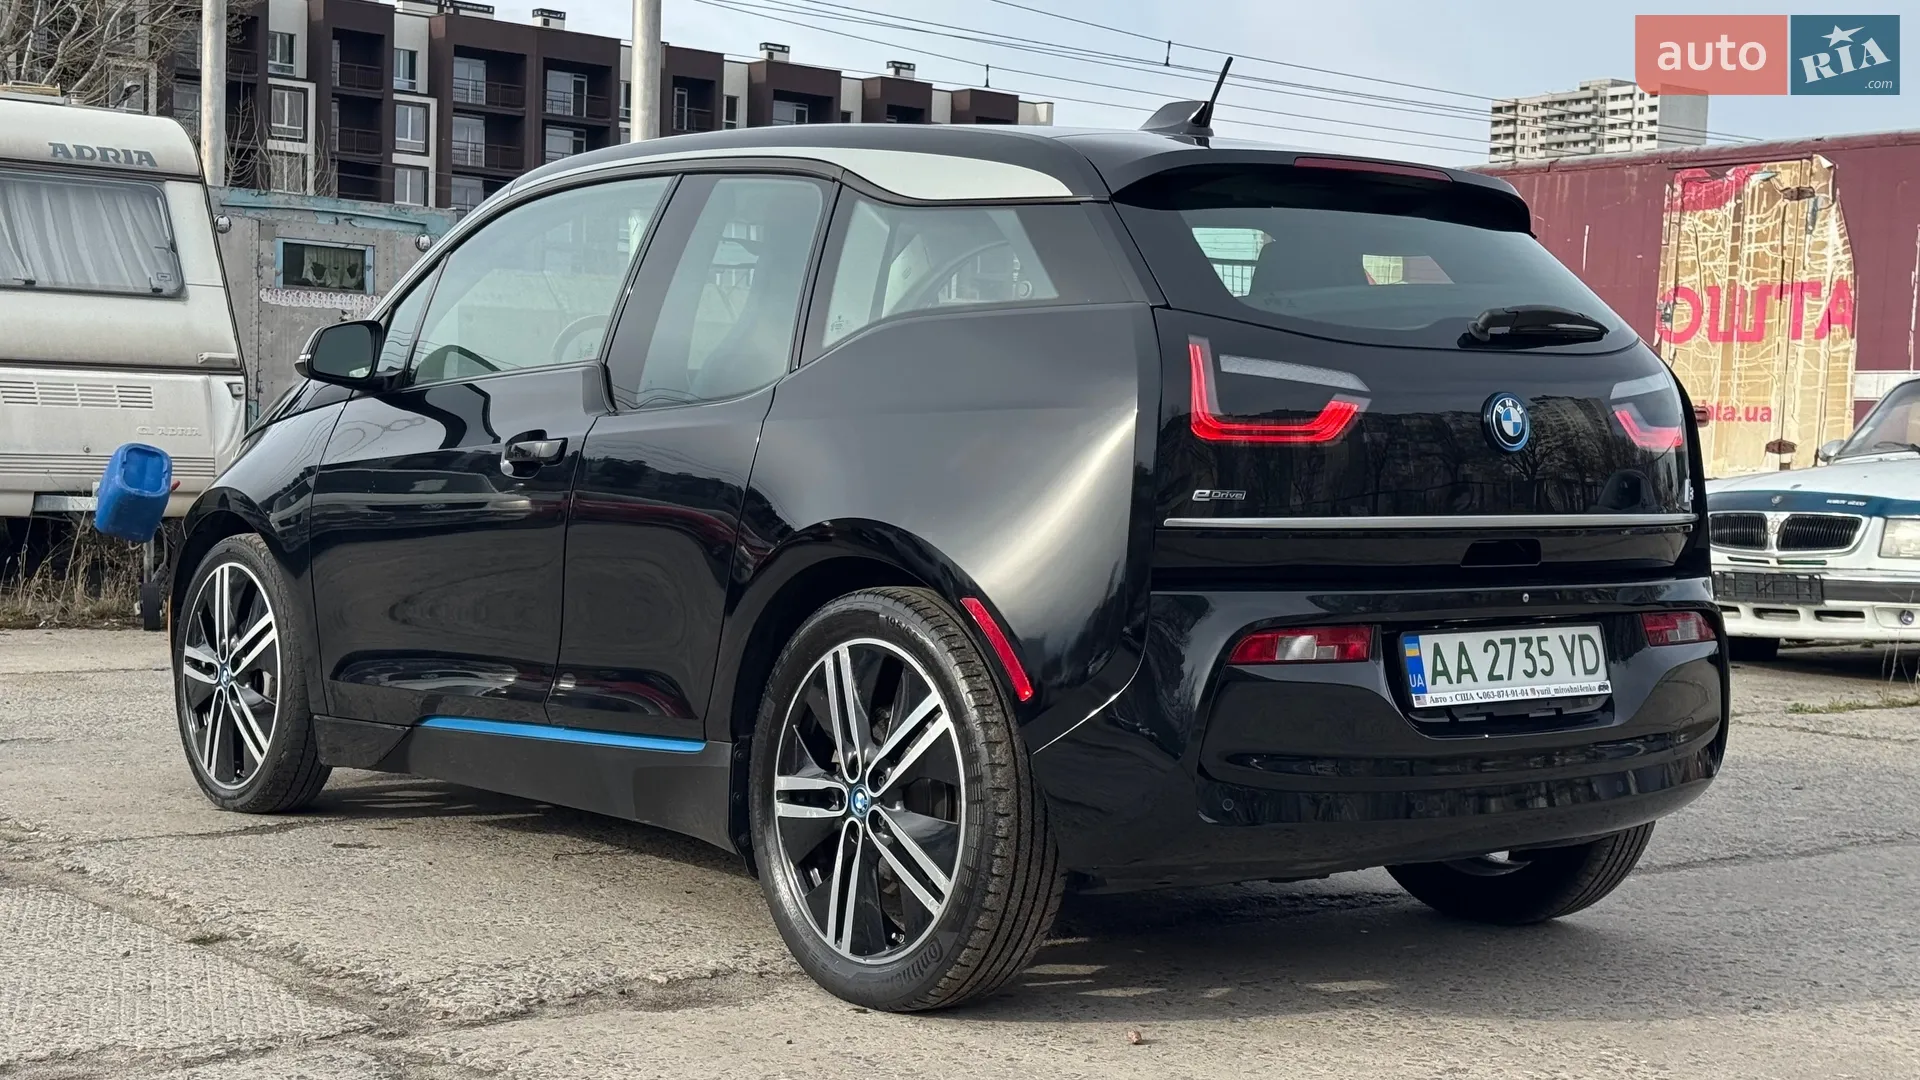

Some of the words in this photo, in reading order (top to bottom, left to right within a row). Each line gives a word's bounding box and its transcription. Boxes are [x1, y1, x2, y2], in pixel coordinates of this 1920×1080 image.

[47, 141, 158, 168] ADRIA
[156, 426, 202, 437] ADRIA
[1192, 489, 1246, 501] eDrive
[1431, 641, 1478, 685] AA
[1483, 636, 1555, 682] 2735
[1558, 634, 1601, 676] YD
[1409, 674, 1425, 688] UA
[1429, 695, 1448, 704] Авто
[1454, 692, 1475, 702] США
